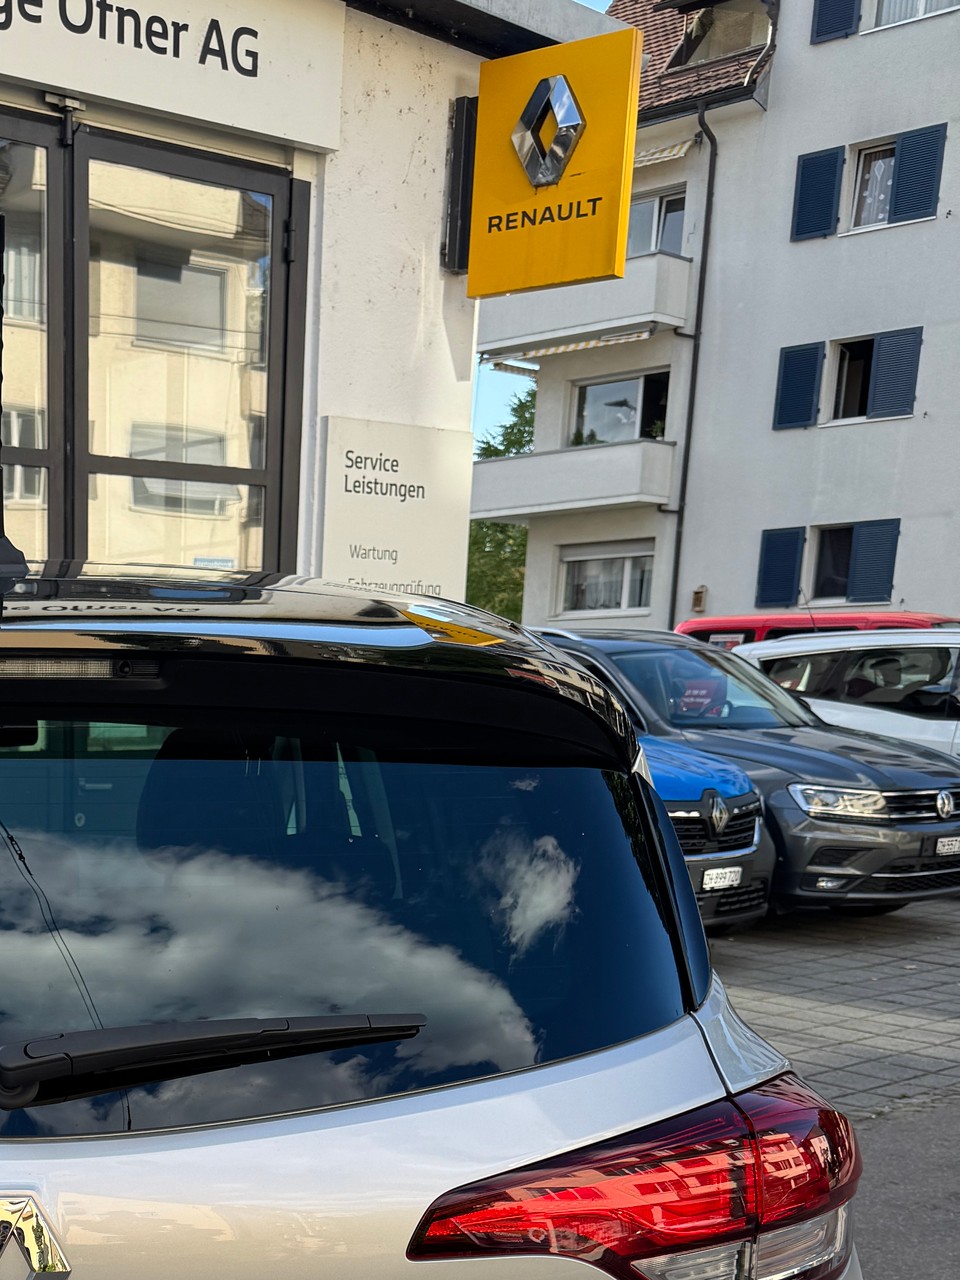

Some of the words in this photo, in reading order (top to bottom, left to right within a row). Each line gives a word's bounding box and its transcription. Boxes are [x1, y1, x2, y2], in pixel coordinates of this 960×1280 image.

[58, 0, 189, 58] Ofner
[198, 18, 260, 77] AG
[487, 197, 603, 234] RENAULT
[344, 450, 399, 473] Service
[344, 474, 425, 502] Leistungen
[349, 544, 398, 565] Wartung
